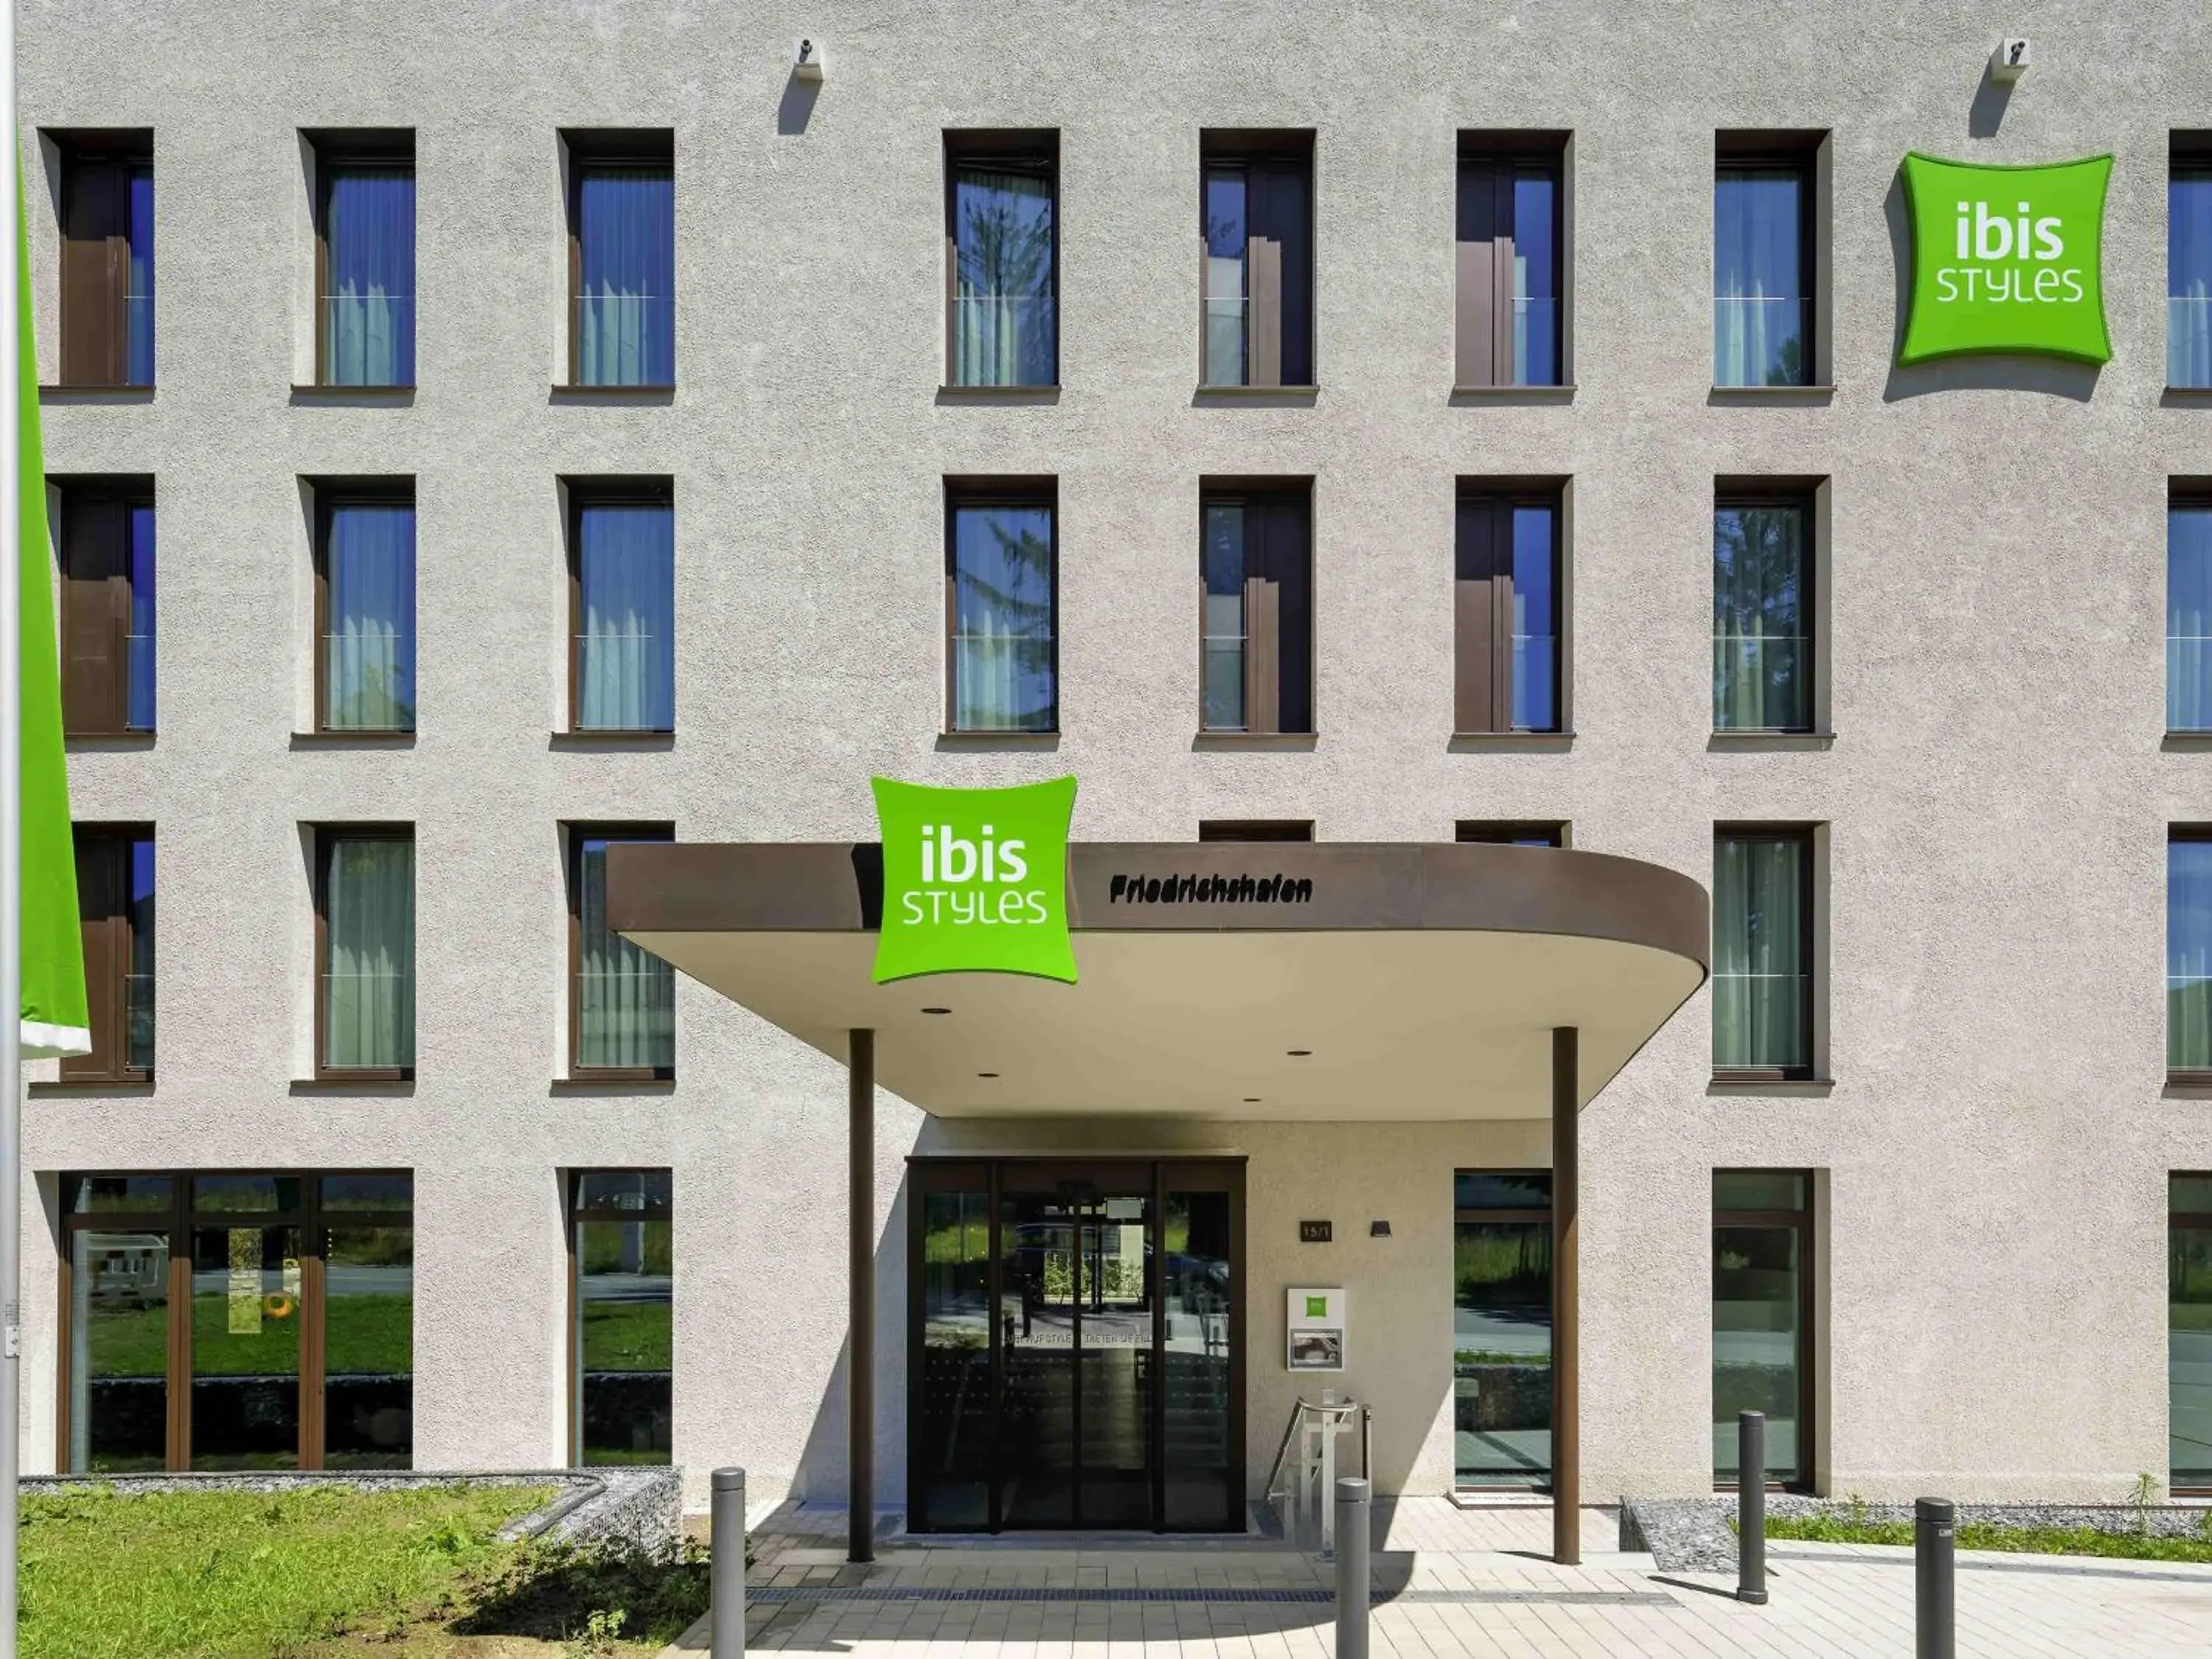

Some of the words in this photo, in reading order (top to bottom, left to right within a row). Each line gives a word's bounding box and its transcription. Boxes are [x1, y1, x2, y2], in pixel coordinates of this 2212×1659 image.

[1957, 201, 2064, 260] ibis
[922, 825, 1027, 883] ibis
[1110, 873, 1312, 903] Friedrichshafen
